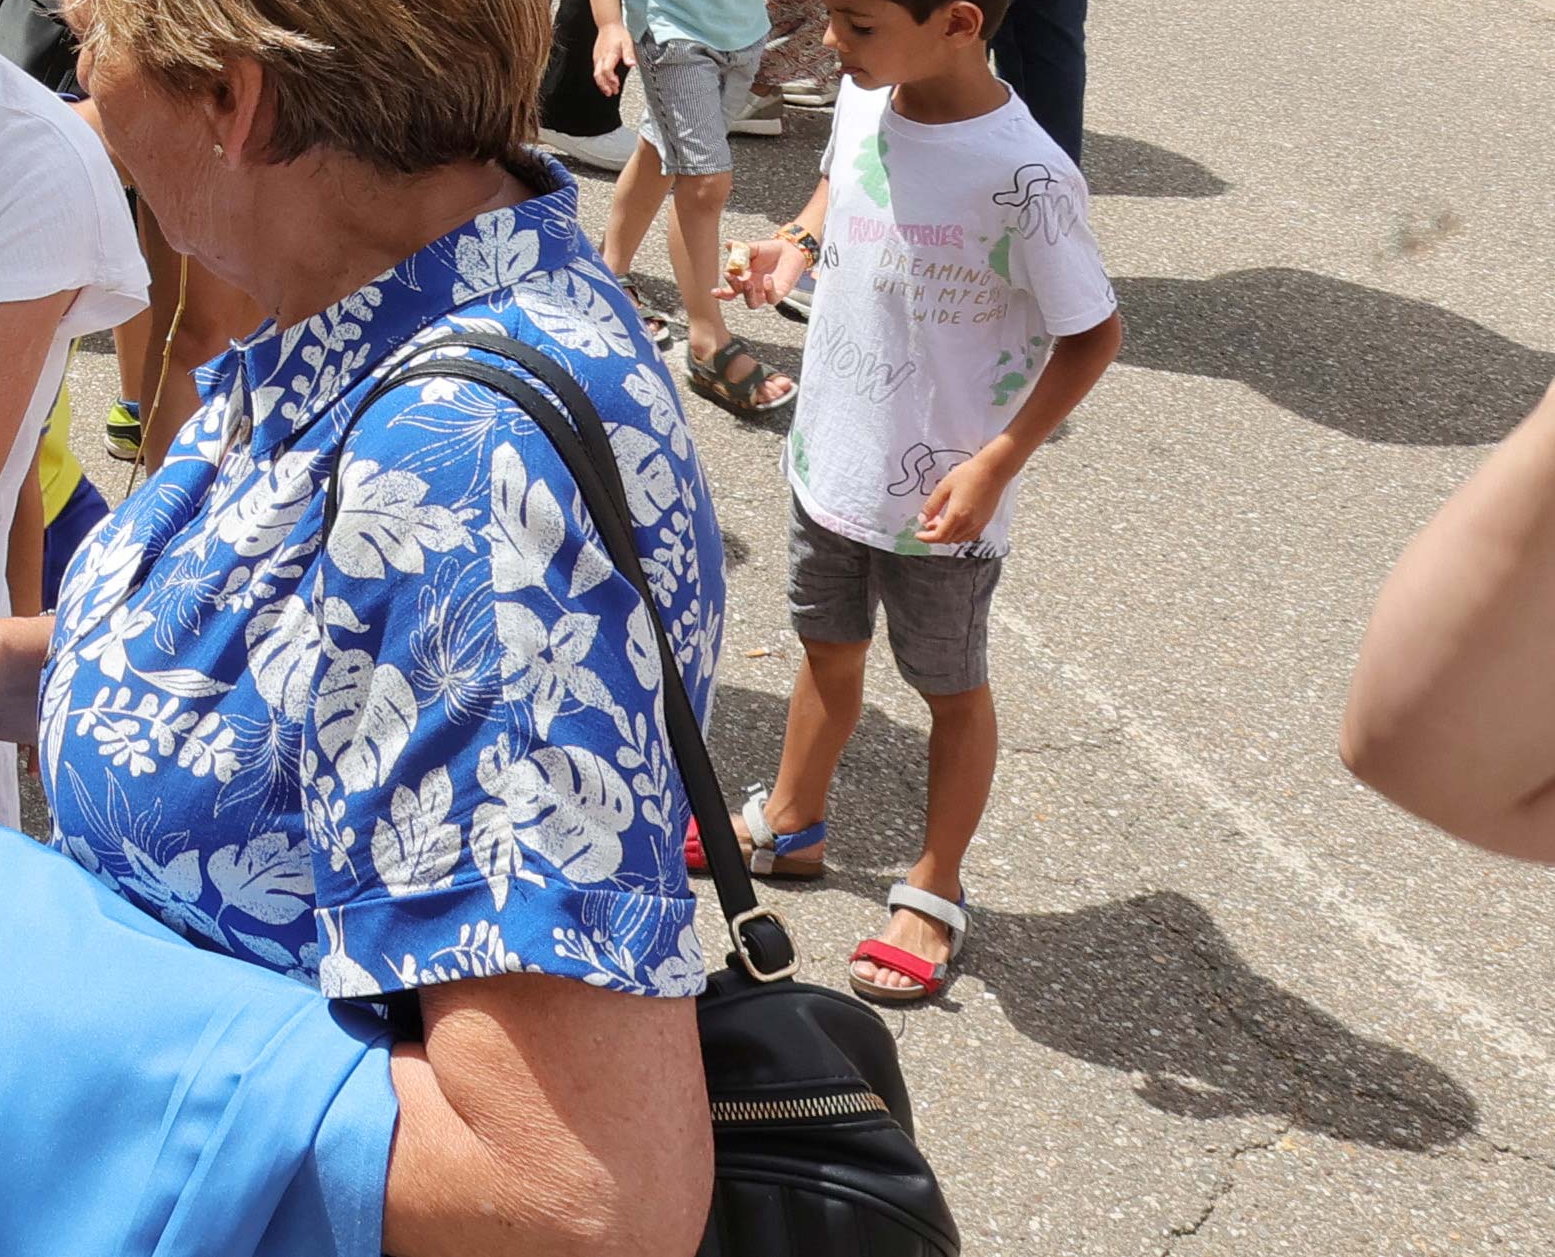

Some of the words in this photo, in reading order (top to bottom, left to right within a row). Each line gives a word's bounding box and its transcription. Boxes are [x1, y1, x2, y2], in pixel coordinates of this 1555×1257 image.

[890, 223, 965, 249] STORIES
[879, 248, 992, 287] DREAMING
[873, 276, 926, 302] WITH
[938, 287, 972, 305] MY
[912, 308, 963, 325] WIDE
[811, 315, 917, 405] NOW
